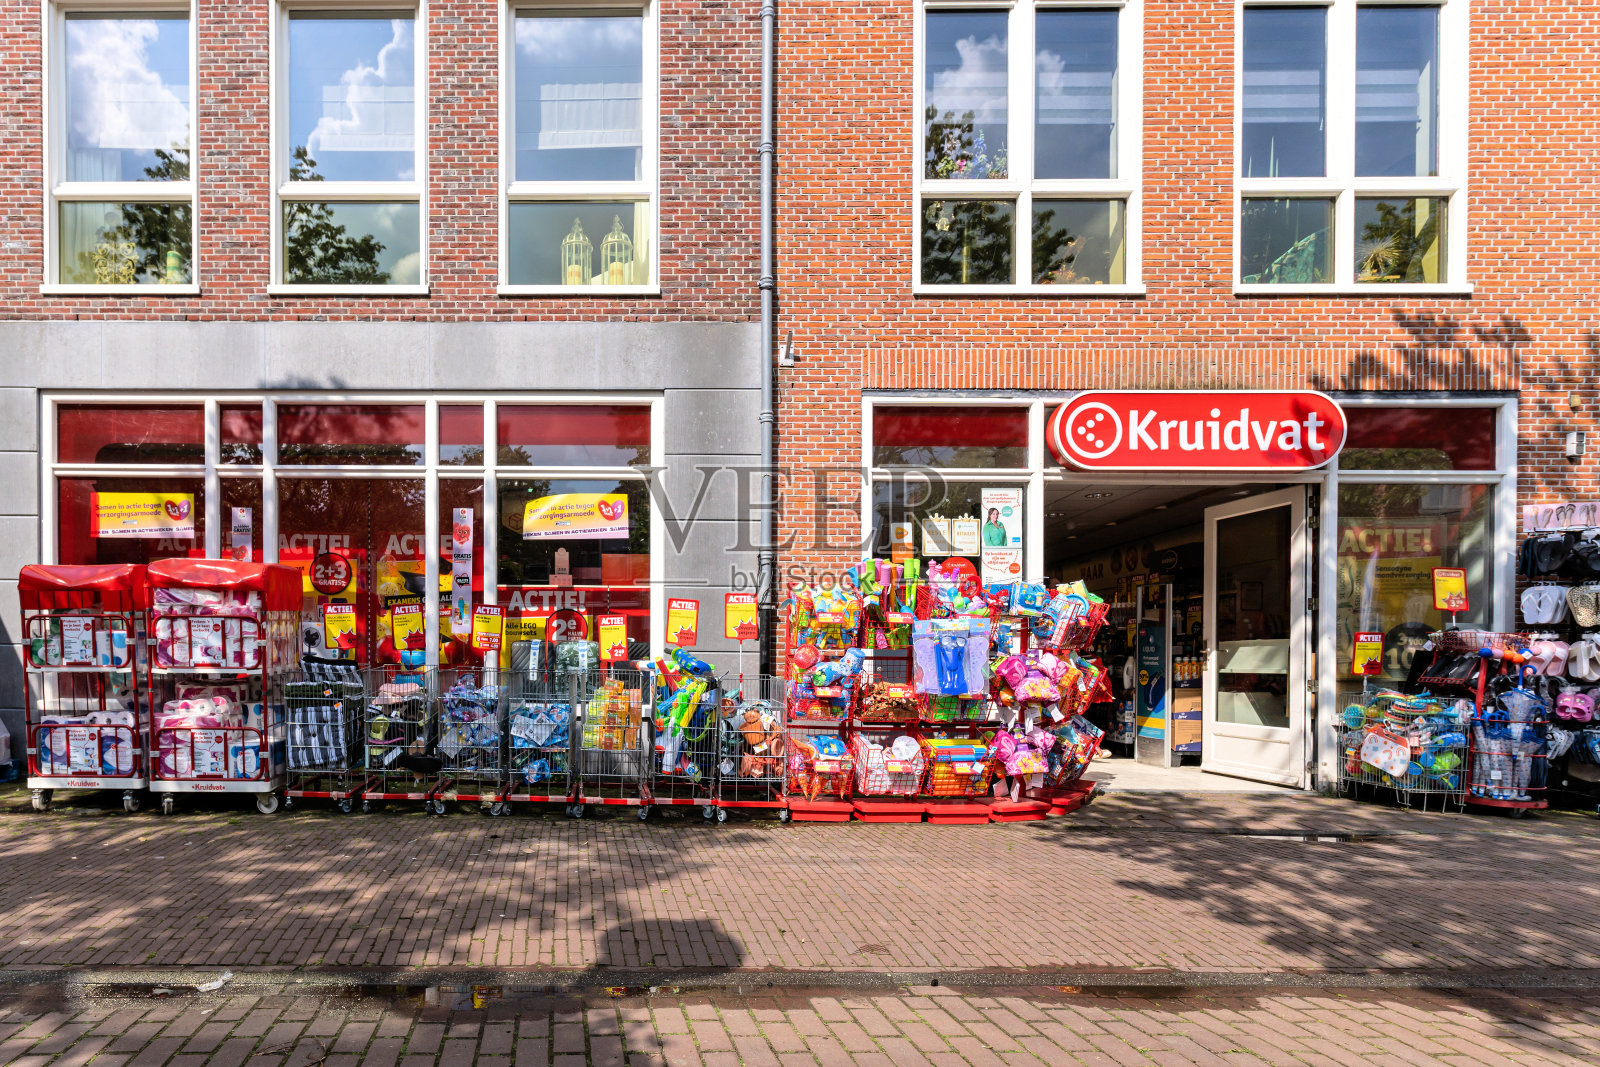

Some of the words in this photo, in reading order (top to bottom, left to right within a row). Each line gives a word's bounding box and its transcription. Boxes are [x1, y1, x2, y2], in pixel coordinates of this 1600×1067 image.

[1129, 408, 1325, 451] Kruidvat
[143, 502, 162, 511] tegen
[96, 510, 162, 518] verzorgingsarmoede
[529, 510, 595, 520] zorgingsarmoede
[1338, 528, 1432, 552] ACTIE!
[279, 534, 350, 556] ACTIE!
[316, 560, 346, 579] 2+3
[1080, 564, 1104, 581] HAAR
[388, 597, 420, 606] EXAMENS
[508, 590, 586, 612] ACTIE!
[672, 601, 696, 610] ACTIE!
[326, 605, 353, 614] ACTIE!
[394, 605, 420, 614] ACTIE!
[476, 606, 500, 616] ACTIE!
[602, 616, 624, 625] ACTIE!
[1360, 634, 1382, 642] ACTIE!
